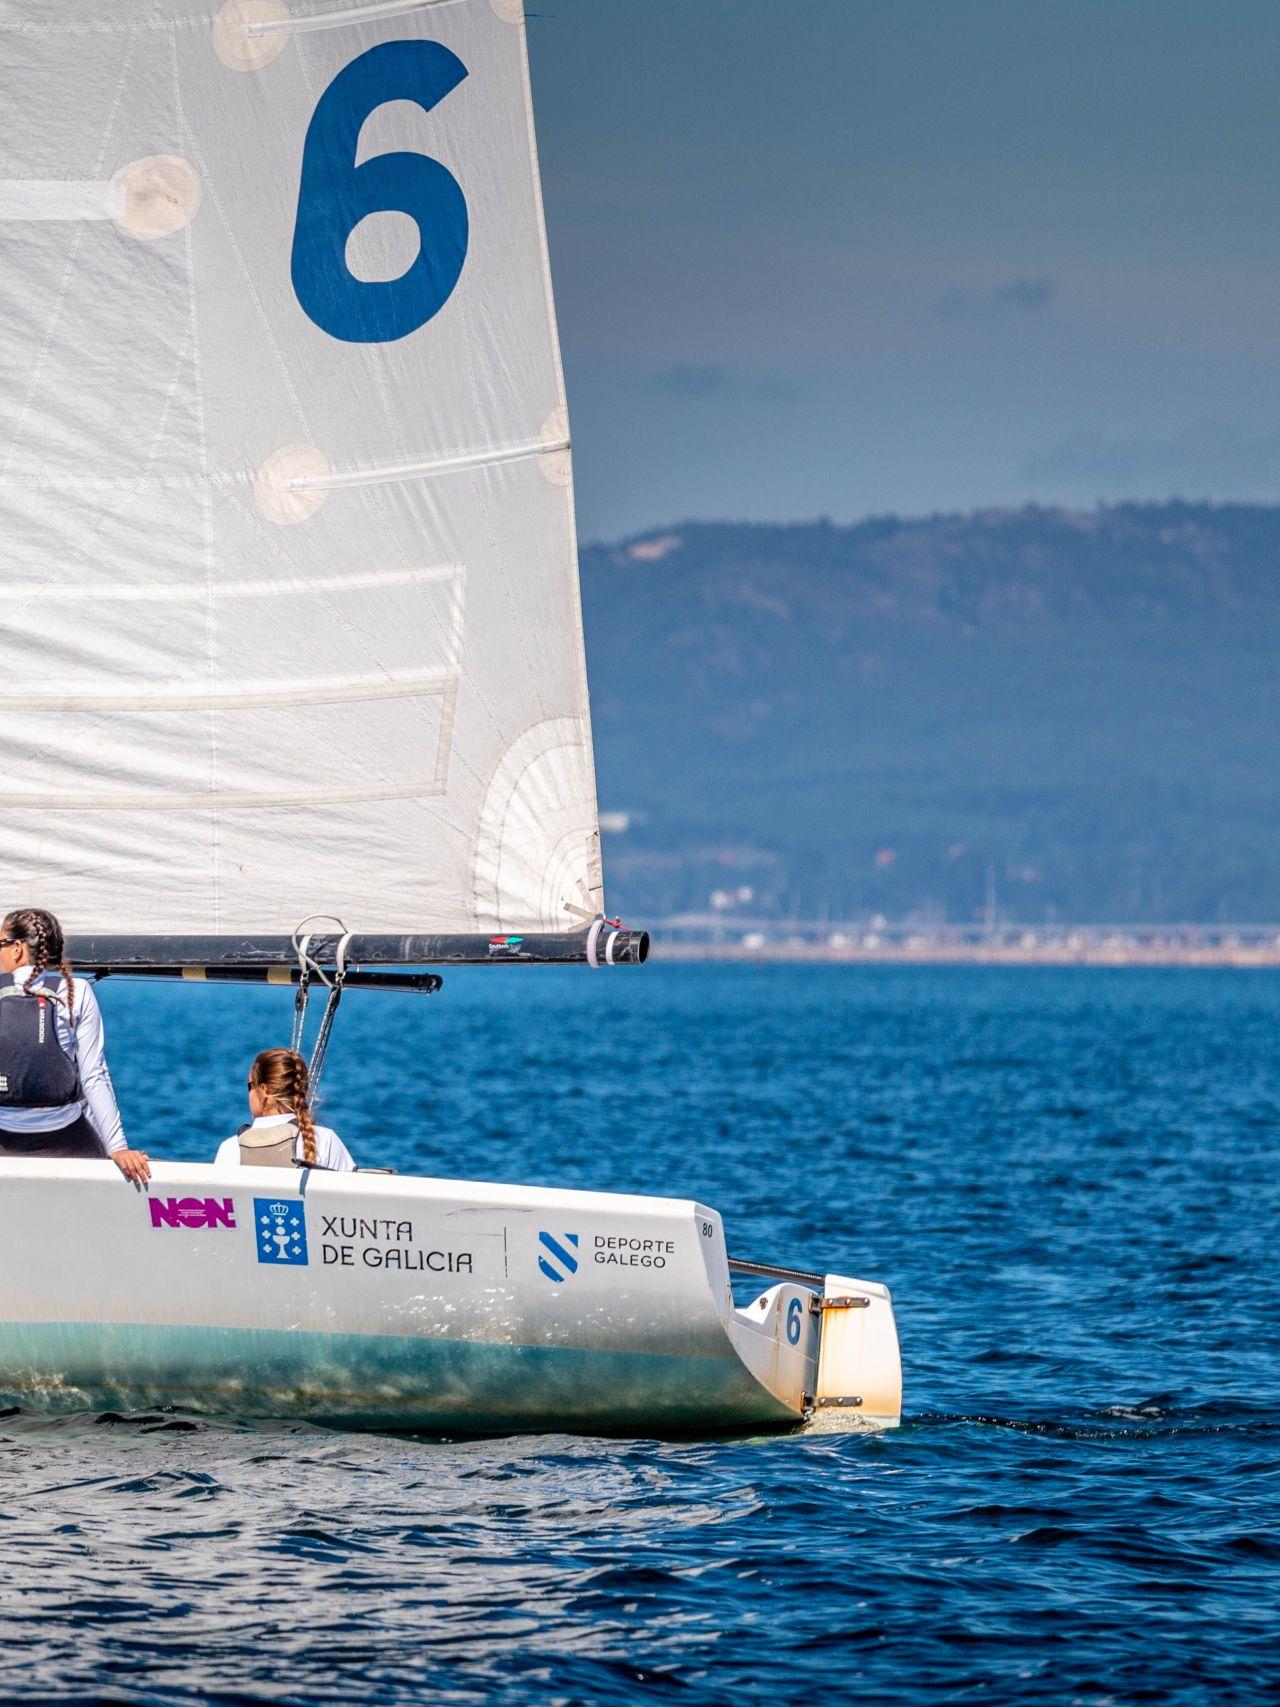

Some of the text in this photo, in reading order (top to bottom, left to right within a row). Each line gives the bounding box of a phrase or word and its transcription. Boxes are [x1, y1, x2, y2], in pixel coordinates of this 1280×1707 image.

[291, 40, 468, 342] 6
[321, 1215, 413, 1242] XUNTA
[702, 1222, 713, 1238] 80
[594, 1235, 675, 1254] DEPORTE
[321, 1244, 473, 1274] DE GALICIA
[594, 1251, 666, 1269] GALEGO
[786, 1297, 803, 1346] 6
